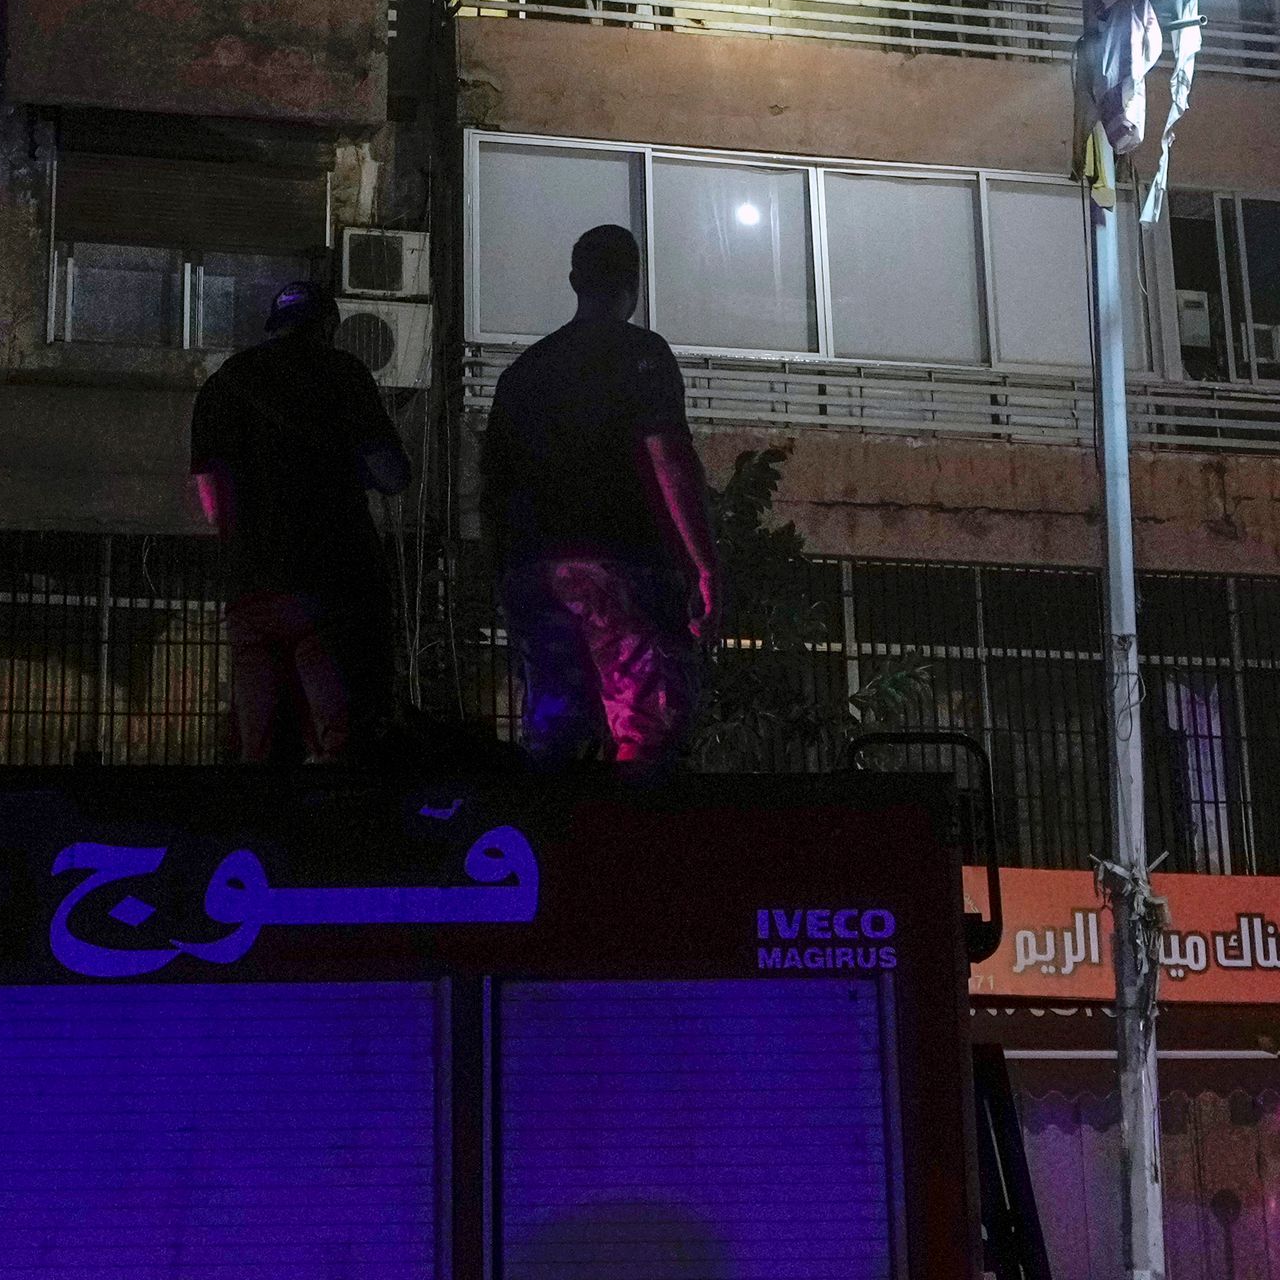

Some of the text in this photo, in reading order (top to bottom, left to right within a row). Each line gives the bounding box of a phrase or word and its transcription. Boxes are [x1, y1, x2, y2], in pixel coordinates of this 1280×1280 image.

[756, 909, 896, 939] IVECO
[757, 946, 897, 969] MAGIRUS
[1013, 912, 1100, 975] الريم
